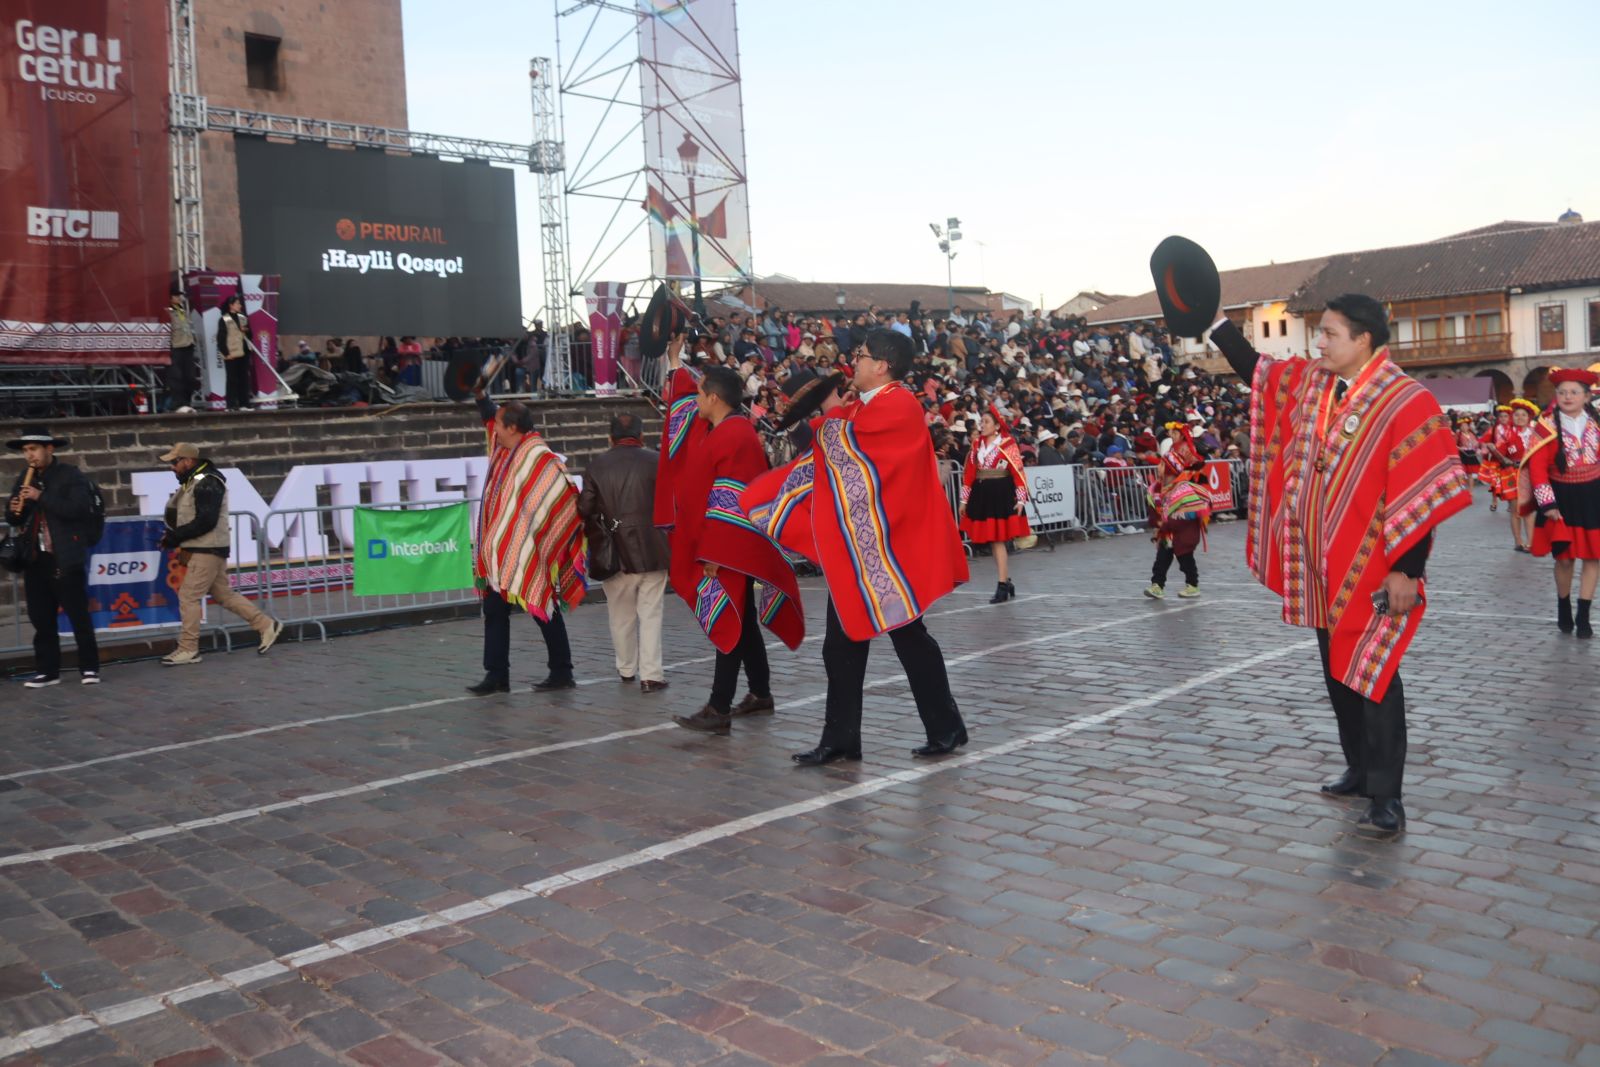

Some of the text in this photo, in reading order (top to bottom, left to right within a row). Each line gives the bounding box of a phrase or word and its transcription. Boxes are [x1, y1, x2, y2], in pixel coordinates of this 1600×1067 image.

[16, 19, 78, 54] Ger
[19, 53, 123, 90] cetur
[360, 221, 448, 245] PERURAIL
[321, 248, 464, 279] ¡Haylli Qosqo!
[1034, 476, 1055, 491] Caja
[1035, 490, 1064, 505] Cusco
[390, 538, 459, 558] Interbank
[106, 560, 140, 576] BCP
